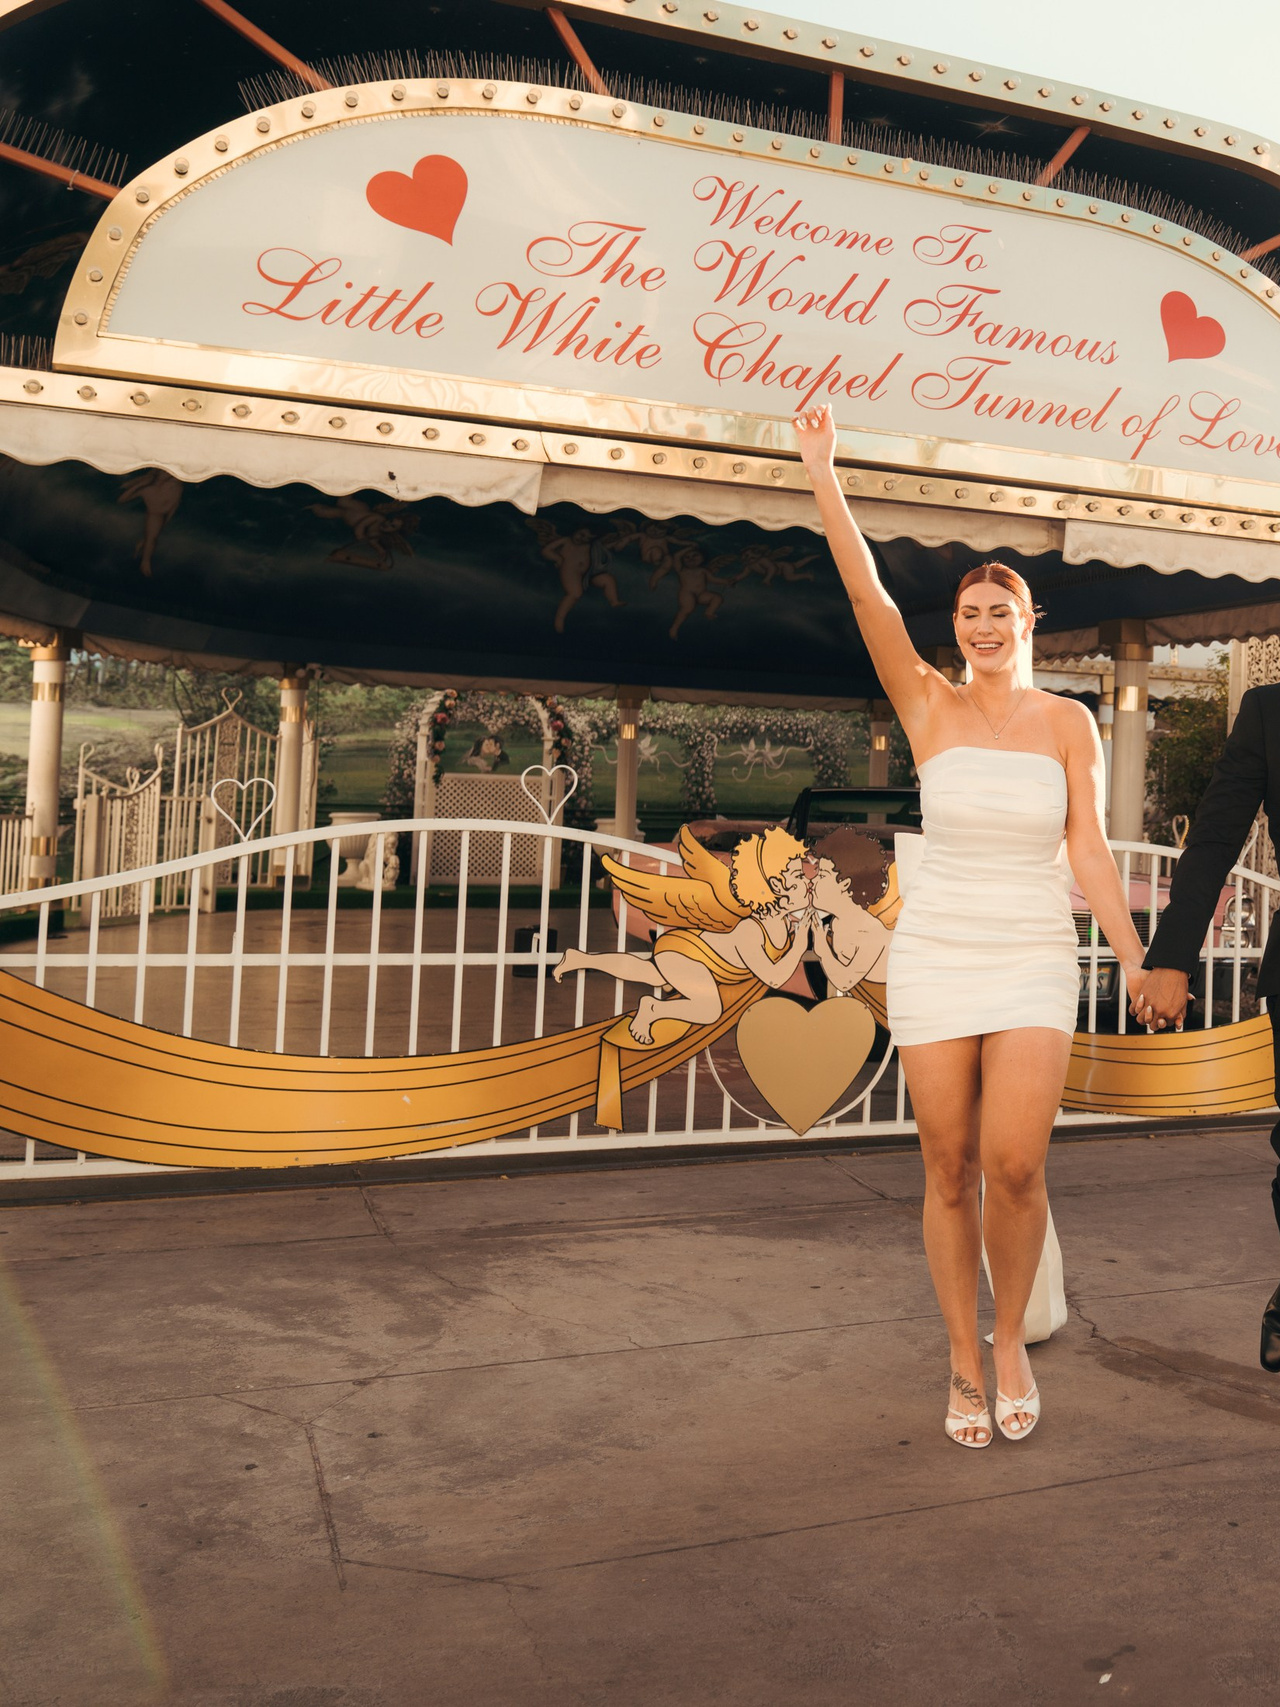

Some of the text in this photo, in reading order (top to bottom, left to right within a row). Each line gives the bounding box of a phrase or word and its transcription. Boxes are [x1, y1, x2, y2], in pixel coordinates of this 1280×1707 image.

[526, 221, 1119, 365] The World Famous
[693, 175, 992, 272] Welcome To
[242, 247, 446, 339] Little
[475, 281, 663, 370] White
[693, 312, 904, 412] Chapel
[911, 356, 1121, 441] Tunnel
[1121, 394, 1180, 460] of
